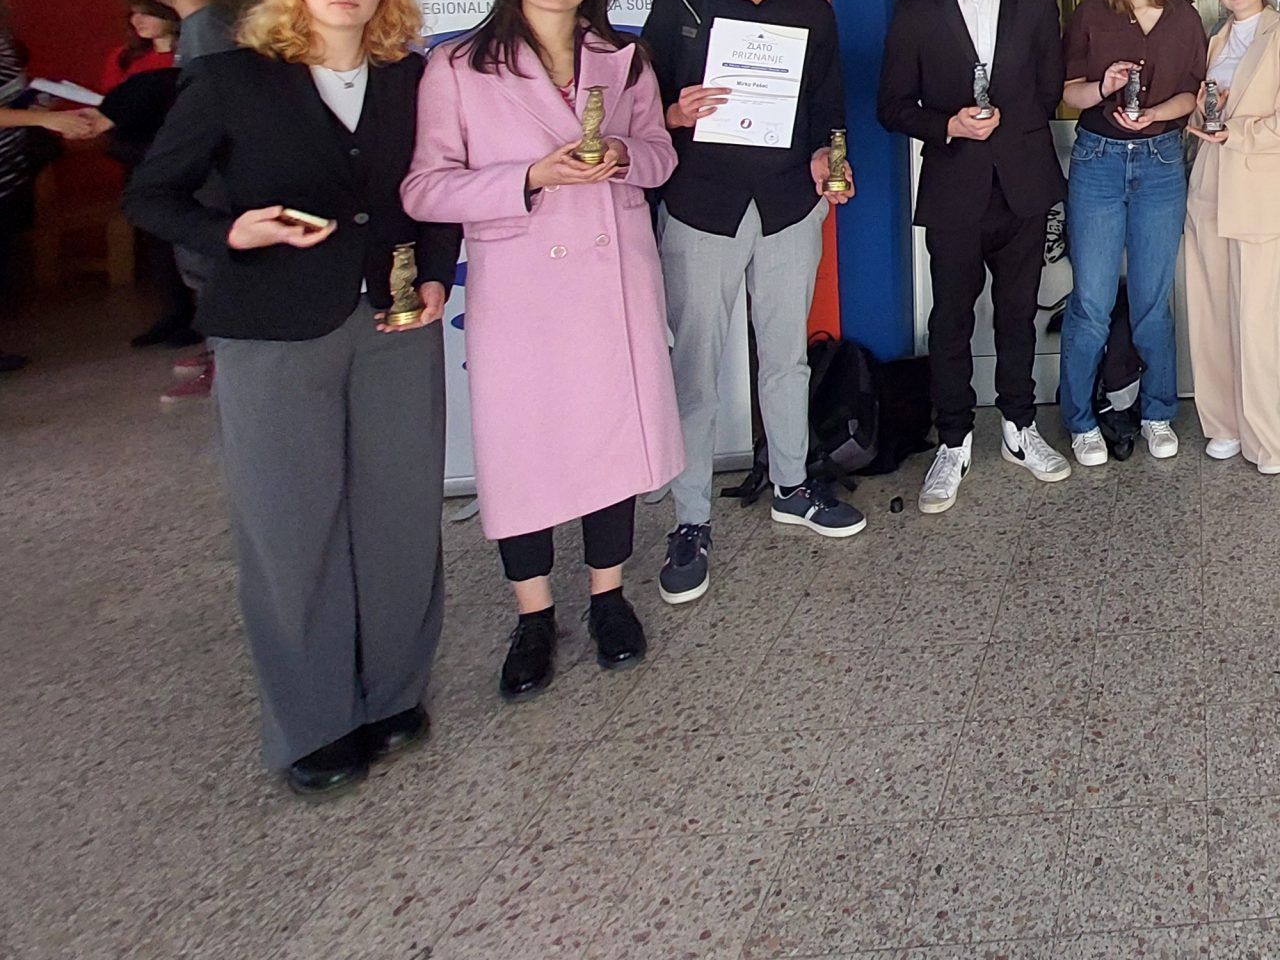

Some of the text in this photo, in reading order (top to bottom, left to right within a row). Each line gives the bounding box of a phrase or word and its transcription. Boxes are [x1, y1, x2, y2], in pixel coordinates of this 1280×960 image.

[422, 1, 497, 15] EGIONALN
[746, 42, 773, 52] ZLATO
[732, 50, 784, 63] PRIZNANJE
